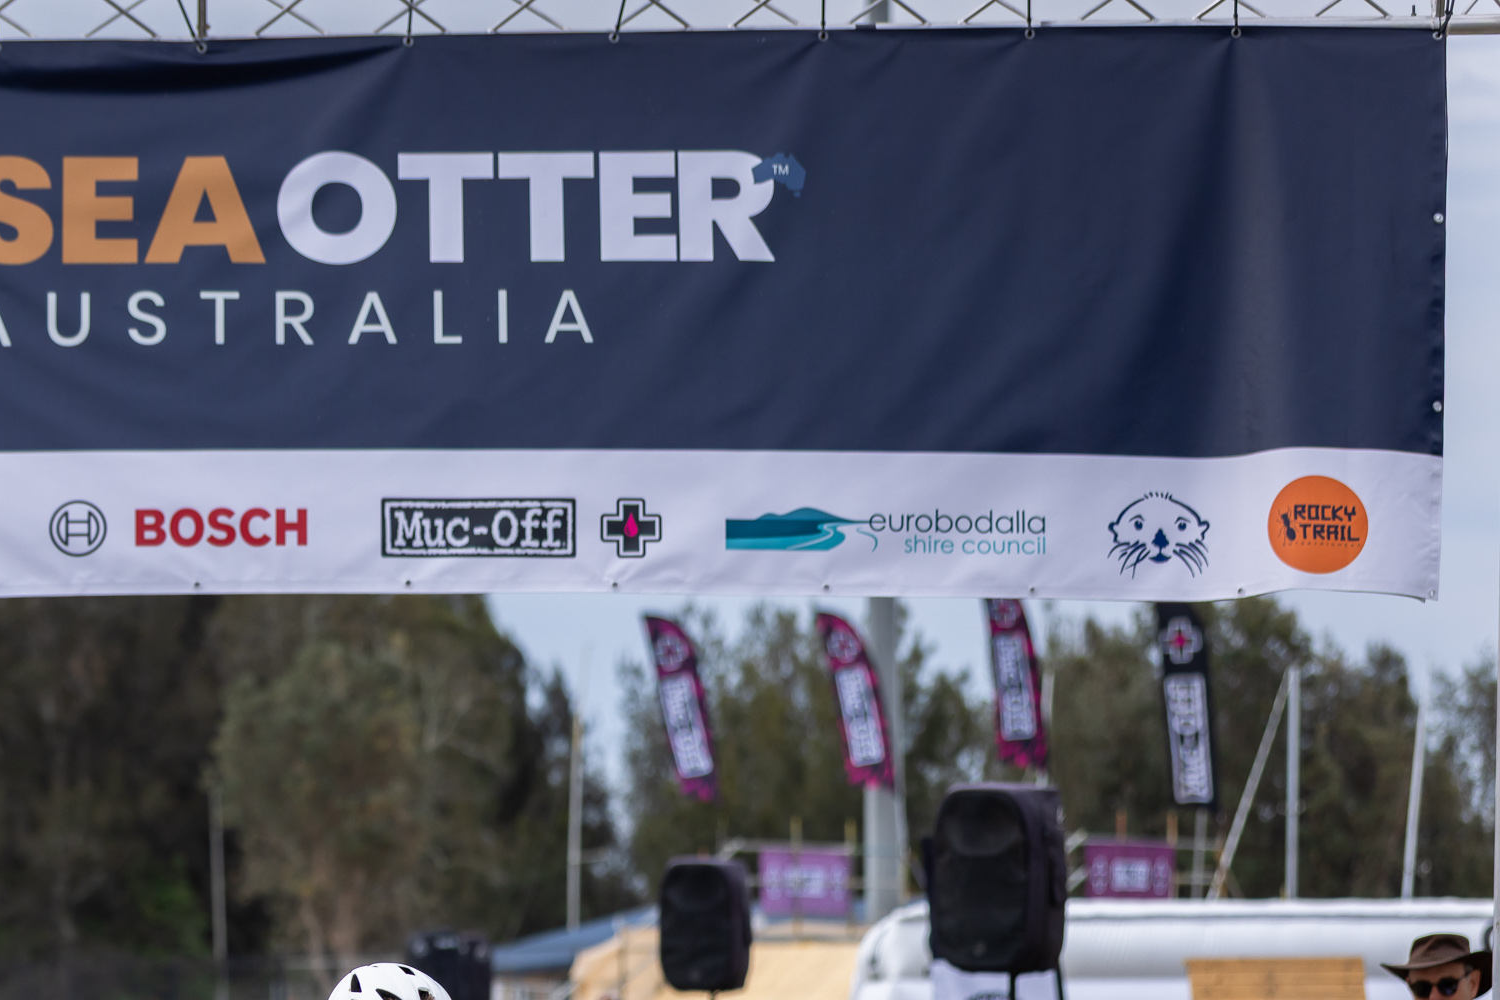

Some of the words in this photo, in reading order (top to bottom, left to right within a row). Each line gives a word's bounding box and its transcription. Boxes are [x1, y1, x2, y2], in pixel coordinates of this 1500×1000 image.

[277, 149, 775, 265] OTTER
[868, 508, 1047, 534] eurobodalla
[1293, 504, 1357, 522] ROCKY
[134, 508, 308, 547] BOSCH
[393, 507, 565, 549] Muc-Off
[1300, 523, 1361, 542] TRAIL
[903, 535, 955, 556] shire
[961, 533, 1047, 556] council
